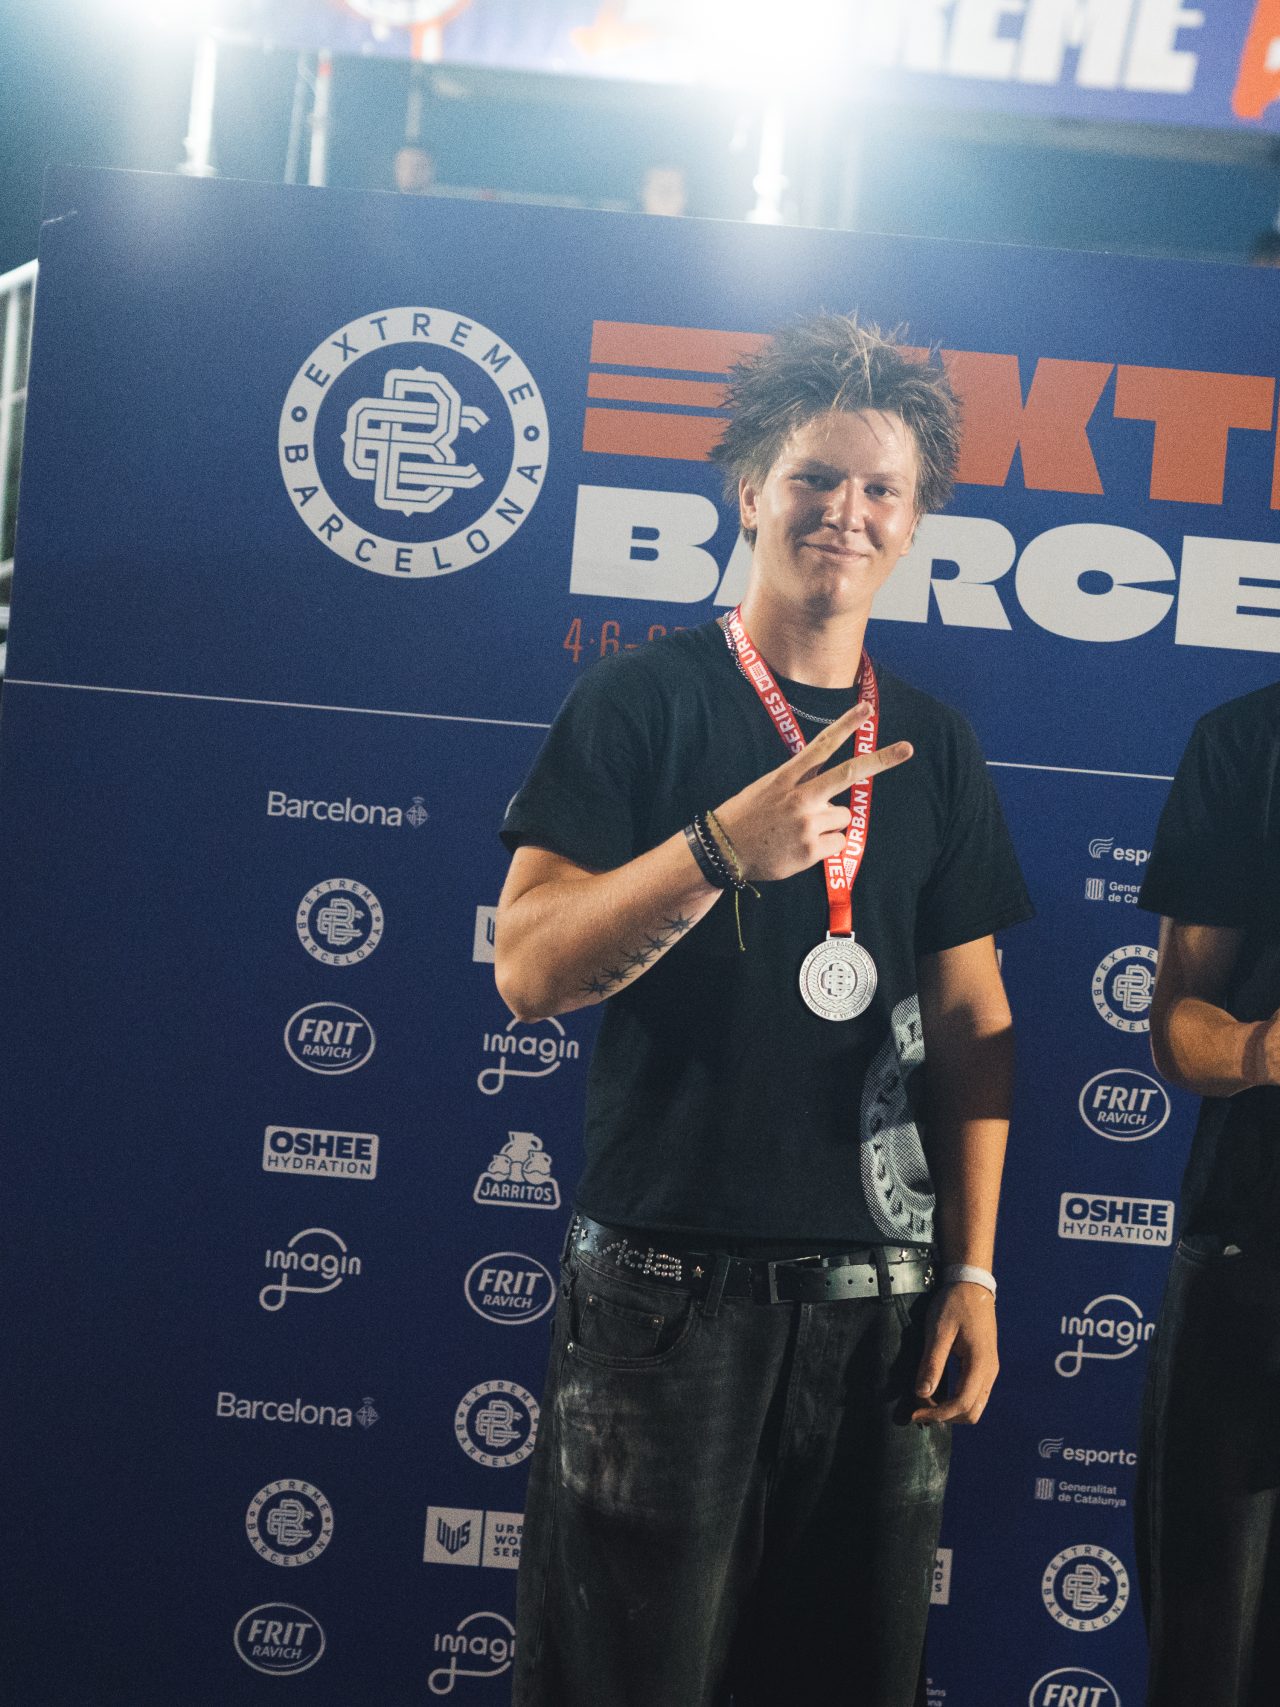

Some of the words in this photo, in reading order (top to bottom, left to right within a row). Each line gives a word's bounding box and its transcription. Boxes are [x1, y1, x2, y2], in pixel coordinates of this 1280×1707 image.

[303, 313, 536, 405] EXTREME
[284, 444, 542, 573] BARCELONA
[857, 719, 875, 754] RLD
[266, 790, 402, 827] Barcelona
[846, 789, 869, 856] URBAN
[304, 880, 379, 910] EXTREME
[298, 923, 381, 964] BARCELONA
[1100, 946, 1155, 973] EXTRE
[1094, 989, 1148, 1032] BARCEL
[298, 1018, 363, 1045] FRIT
[302, 1044, 352, 1059] RAVICH
[483, 1033, 580, 1064] imagin
[1092, 1085, 1159, 1112] FRIT
[1097, 1111, 1147, 1125] RAVICH
[269, 1131, 373, 1161] OSHEE
[267, 1155, 372, 1175] HYDRATION
[480, 1182, 552, 1201] JARRITOS
[1065, 1197, 1168, 1228] OSHEE
[1063, 1222, 1167, 1242] HYDRATION
[265, 1249, 362, 1280] imagin
[478, 1268, 544, 1296] FRIT
[482, 1294, 533, 1309] RAVICH
[216, 1391, 352, 1428] Barcelona
[1063, 1446, 1137, 1466] esportc
[254, 1481, 329, 1511] EXTREME
[1058, 1492, 1072, 1502] de
[1074, 1493, 1127, 1508] Catalunya
[1059, 1481, 1117, 1495] Generalitat
[495, 1523, 523, 1534] URB
[247, 1523, 331, 1565] BARCELONA
[493, 1547, 521, 1558] SER
[1050, 1546, 1125, 1576] EXTREME
[1043, 1588, 1128, 1630] BARCELONA
[248, 1619, 313, 1647] FRIT
[252, 1645, 302, 1660] RAVICH
[434, 1633, 516, 1663] imagi
[1043, 1684, 1108, 1707] FRIT
